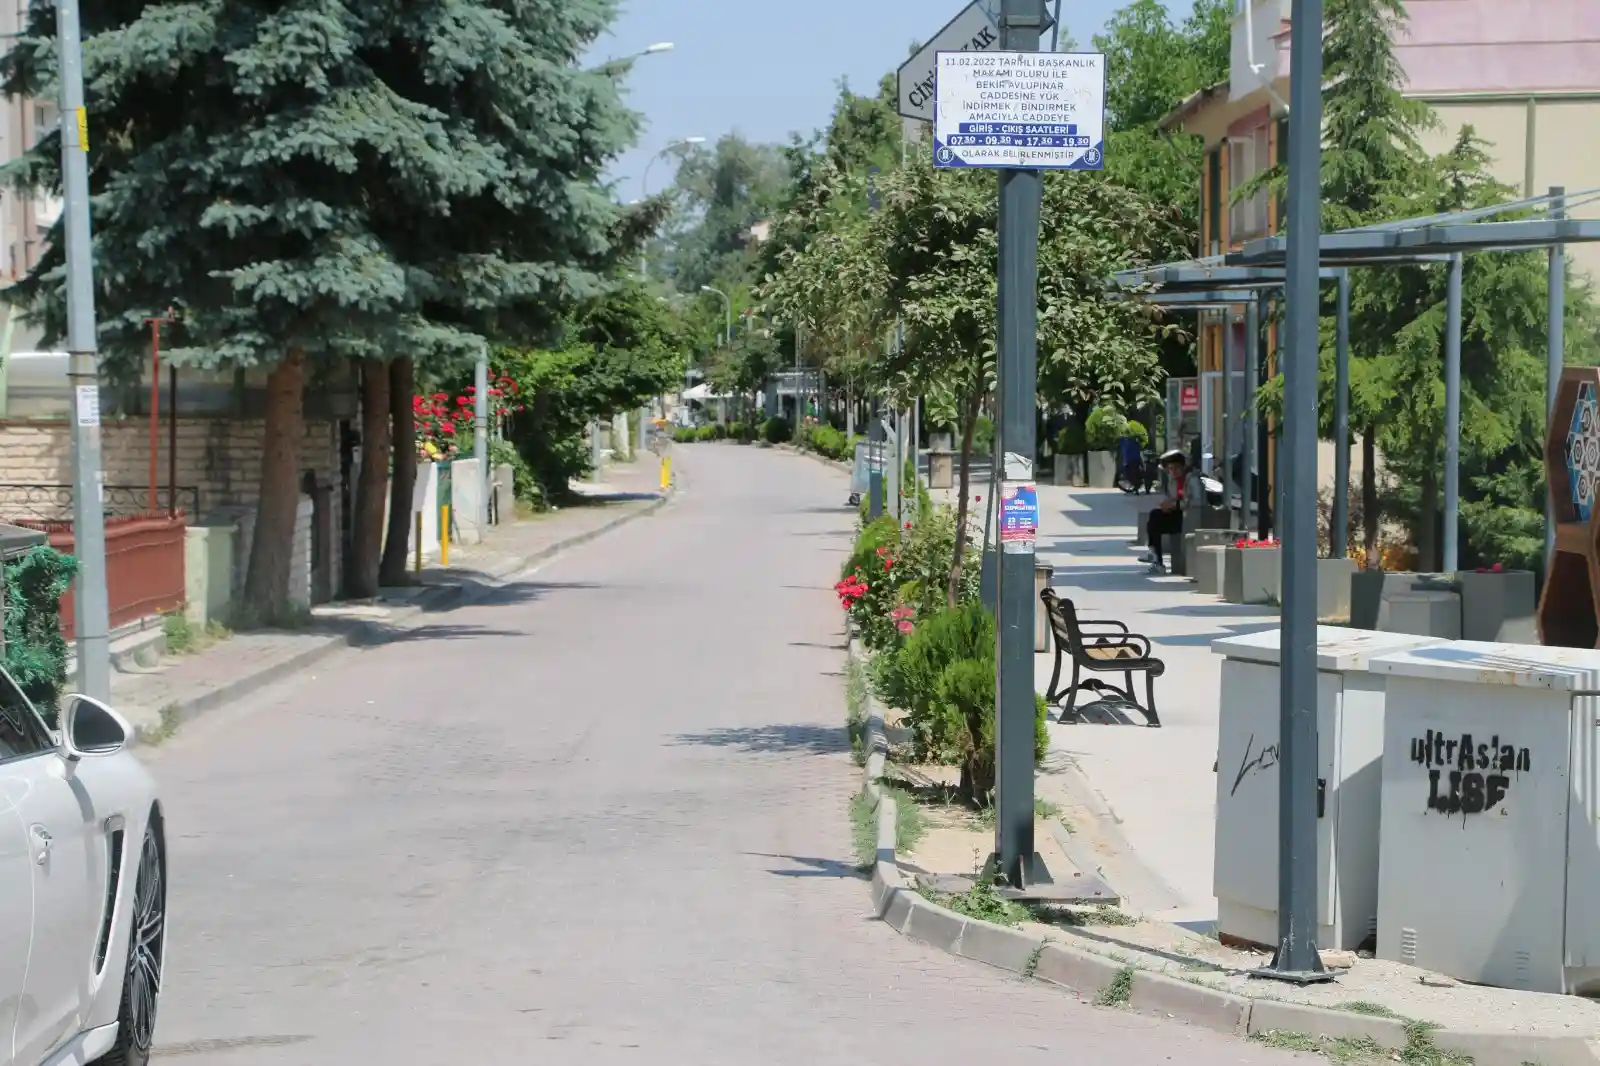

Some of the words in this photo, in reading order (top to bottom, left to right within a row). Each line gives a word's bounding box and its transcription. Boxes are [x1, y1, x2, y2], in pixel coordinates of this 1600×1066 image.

[945, 57, 996, 66] 11.02.2022
[1038, 59, 1096, 68] BAŞKANLIK
[963, 100, 1010, 110] İNDİRMEK
[1022, 113, 1070, 122] CADDEYE
[969, 123, 993, 134] GİRİŞ
[951, 136, 976, 145] 07.30
[985, 136, 1011, 145] 09.30
[1026, 136, 1053, 146] 17.30
[1062, 137, 1089, 146] 19.30
[962, 149, 998, 158] OLARAK
